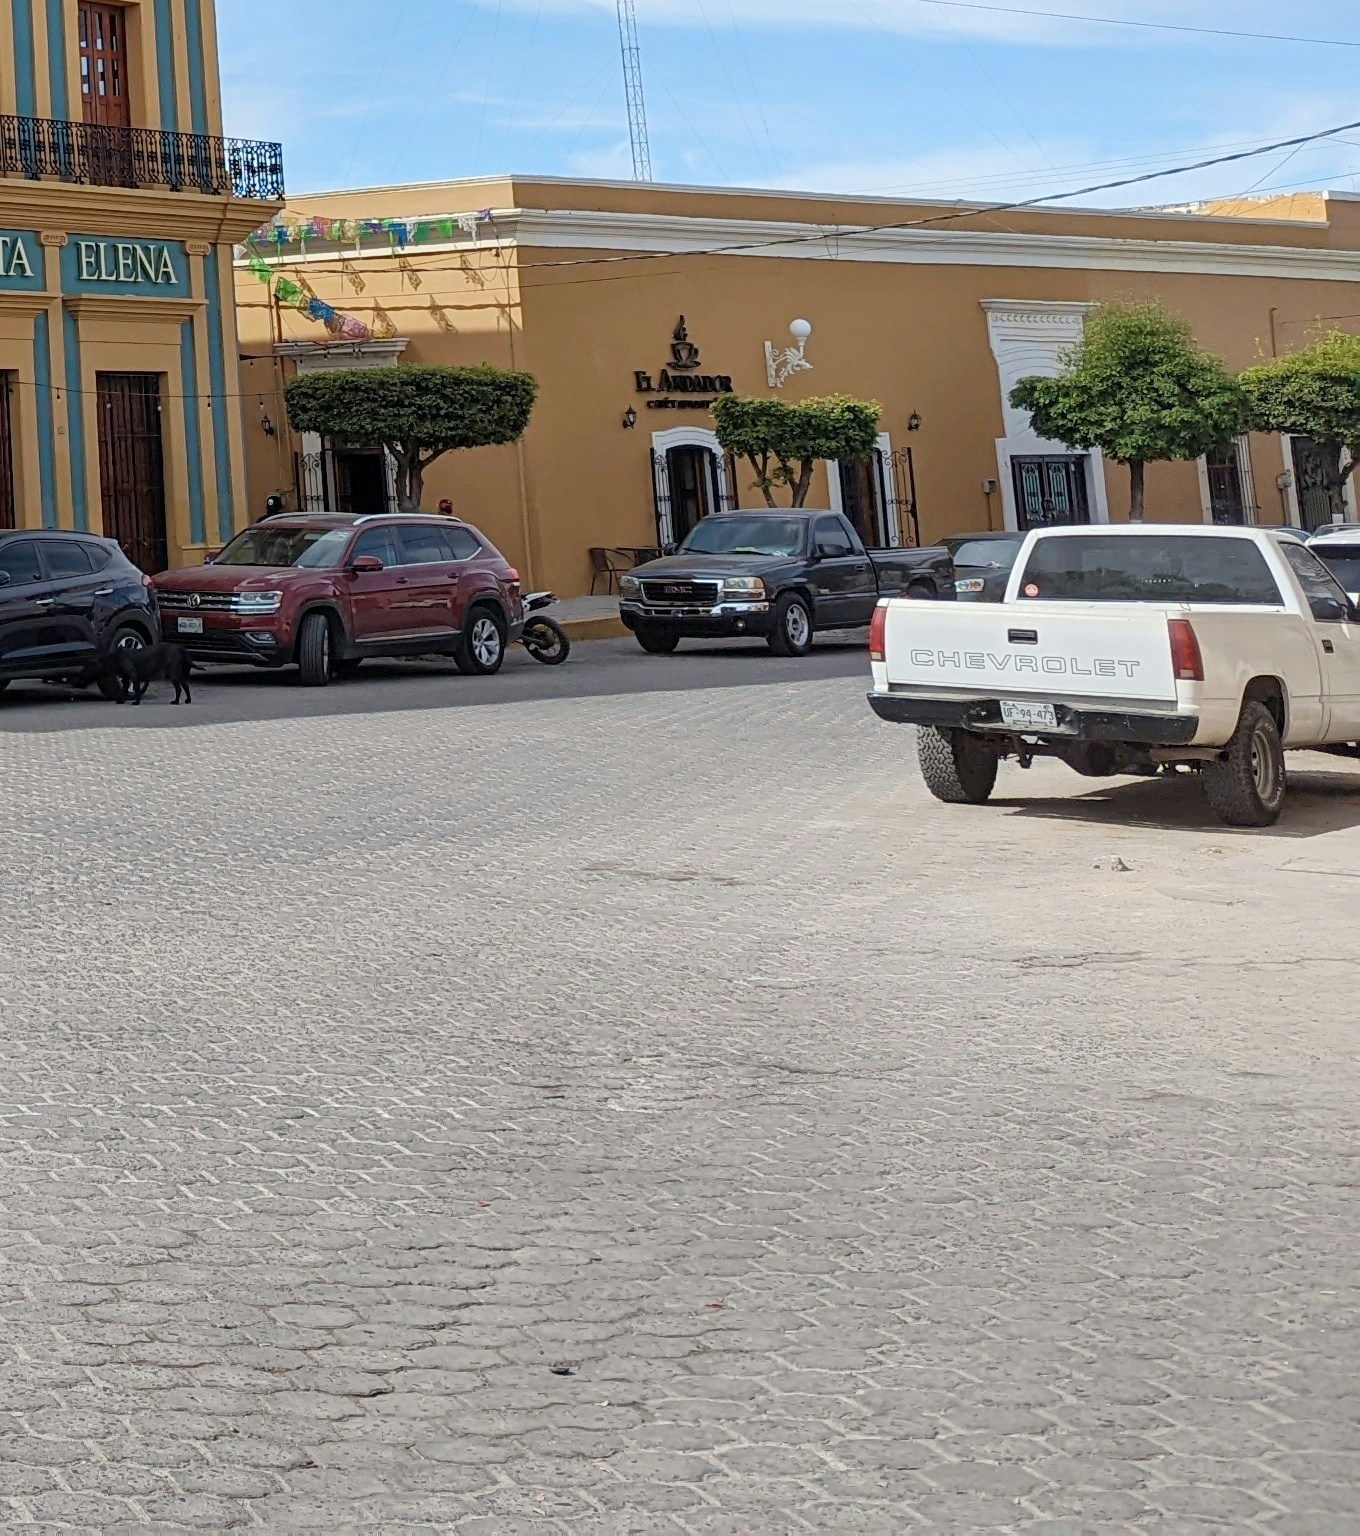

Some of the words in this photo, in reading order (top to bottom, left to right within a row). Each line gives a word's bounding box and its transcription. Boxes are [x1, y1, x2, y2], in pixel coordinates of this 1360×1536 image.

[78, 240, 178, 284] ELENA
[664, 586, 693, 594] GMC
[911, 649, 1141, 677] CHEVROLET
